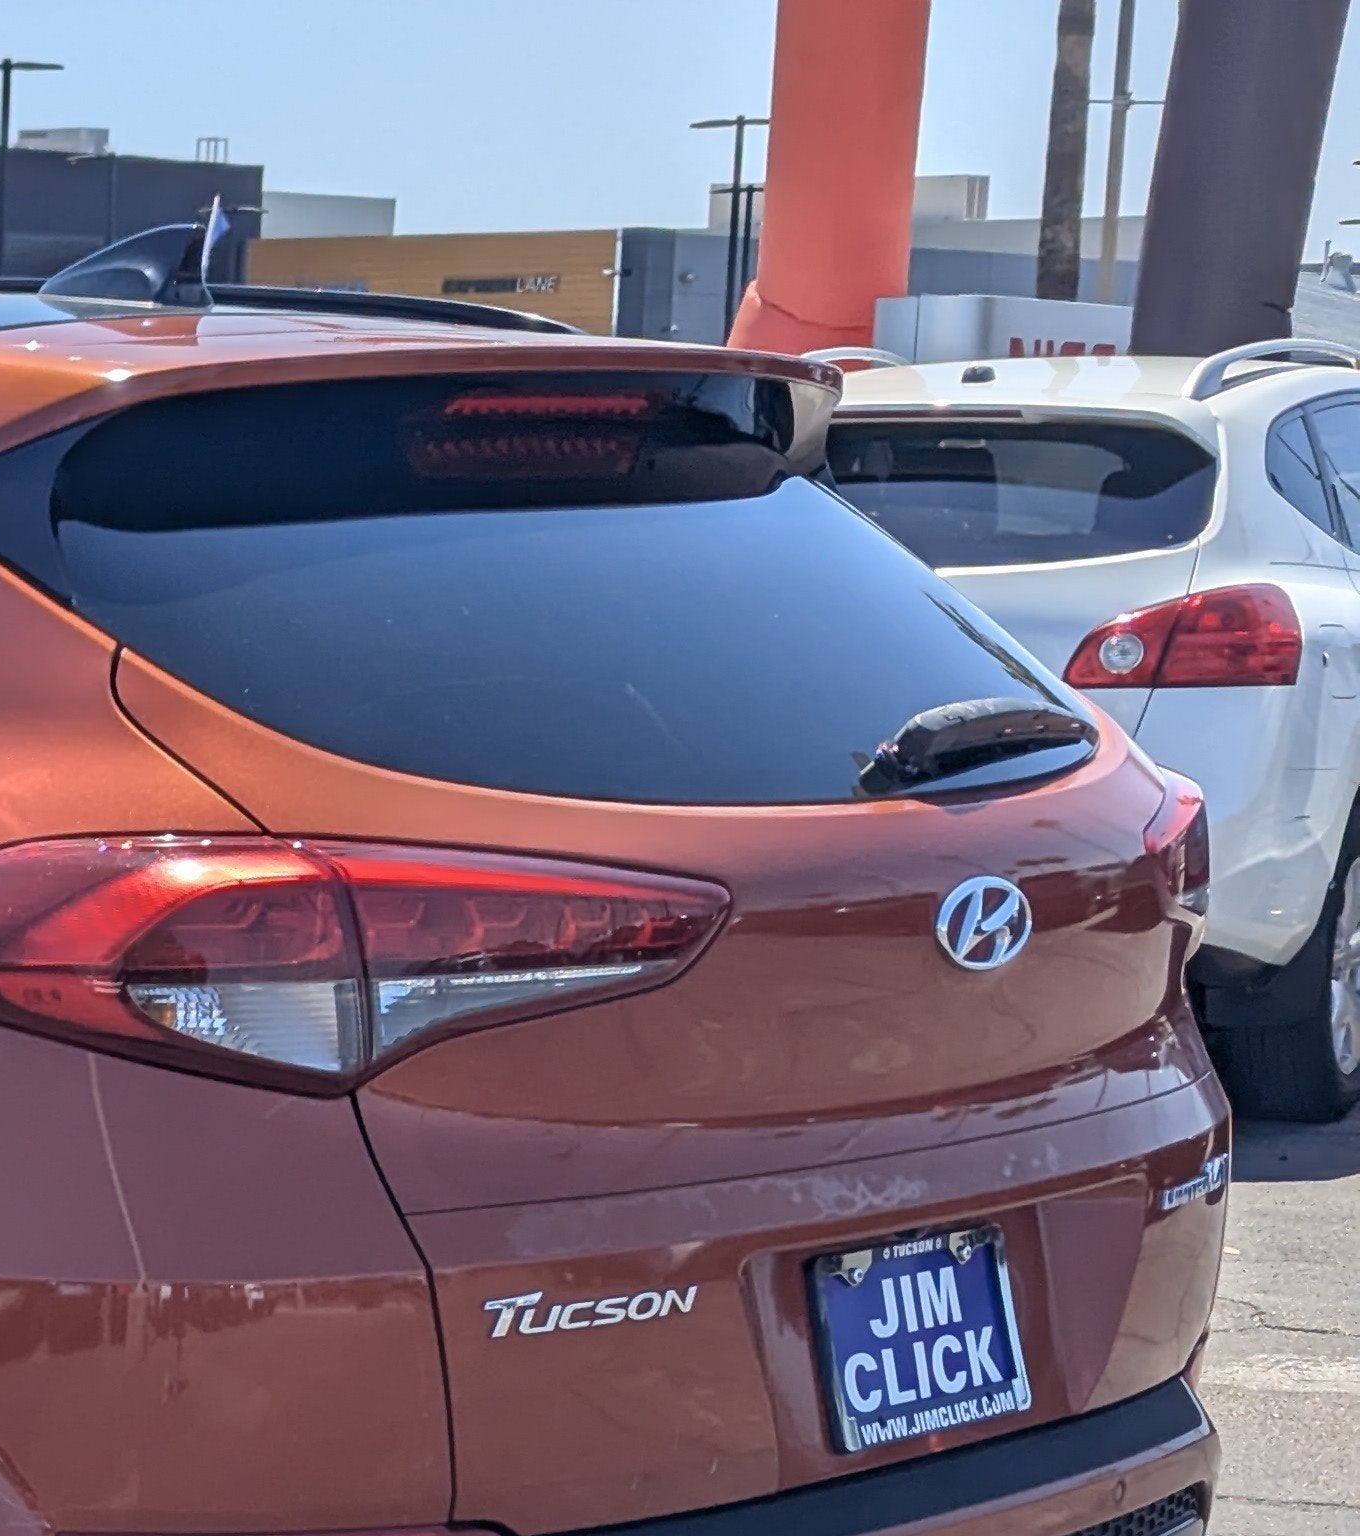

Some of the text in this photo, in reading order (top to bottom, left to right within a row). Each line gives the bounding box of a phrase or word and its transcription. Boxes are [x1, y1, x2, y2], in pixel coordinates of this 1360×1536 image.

[893, 1238, 934, 1258] TUCSON
[484, 1286, 698, 1338] TUCSON
[870, 1266, 962, 1339] JIM
[844, 1326, 1003, 1413] CLICK
[861, 1390, 1015, 1446] WWW.JIMCLICK.COM
